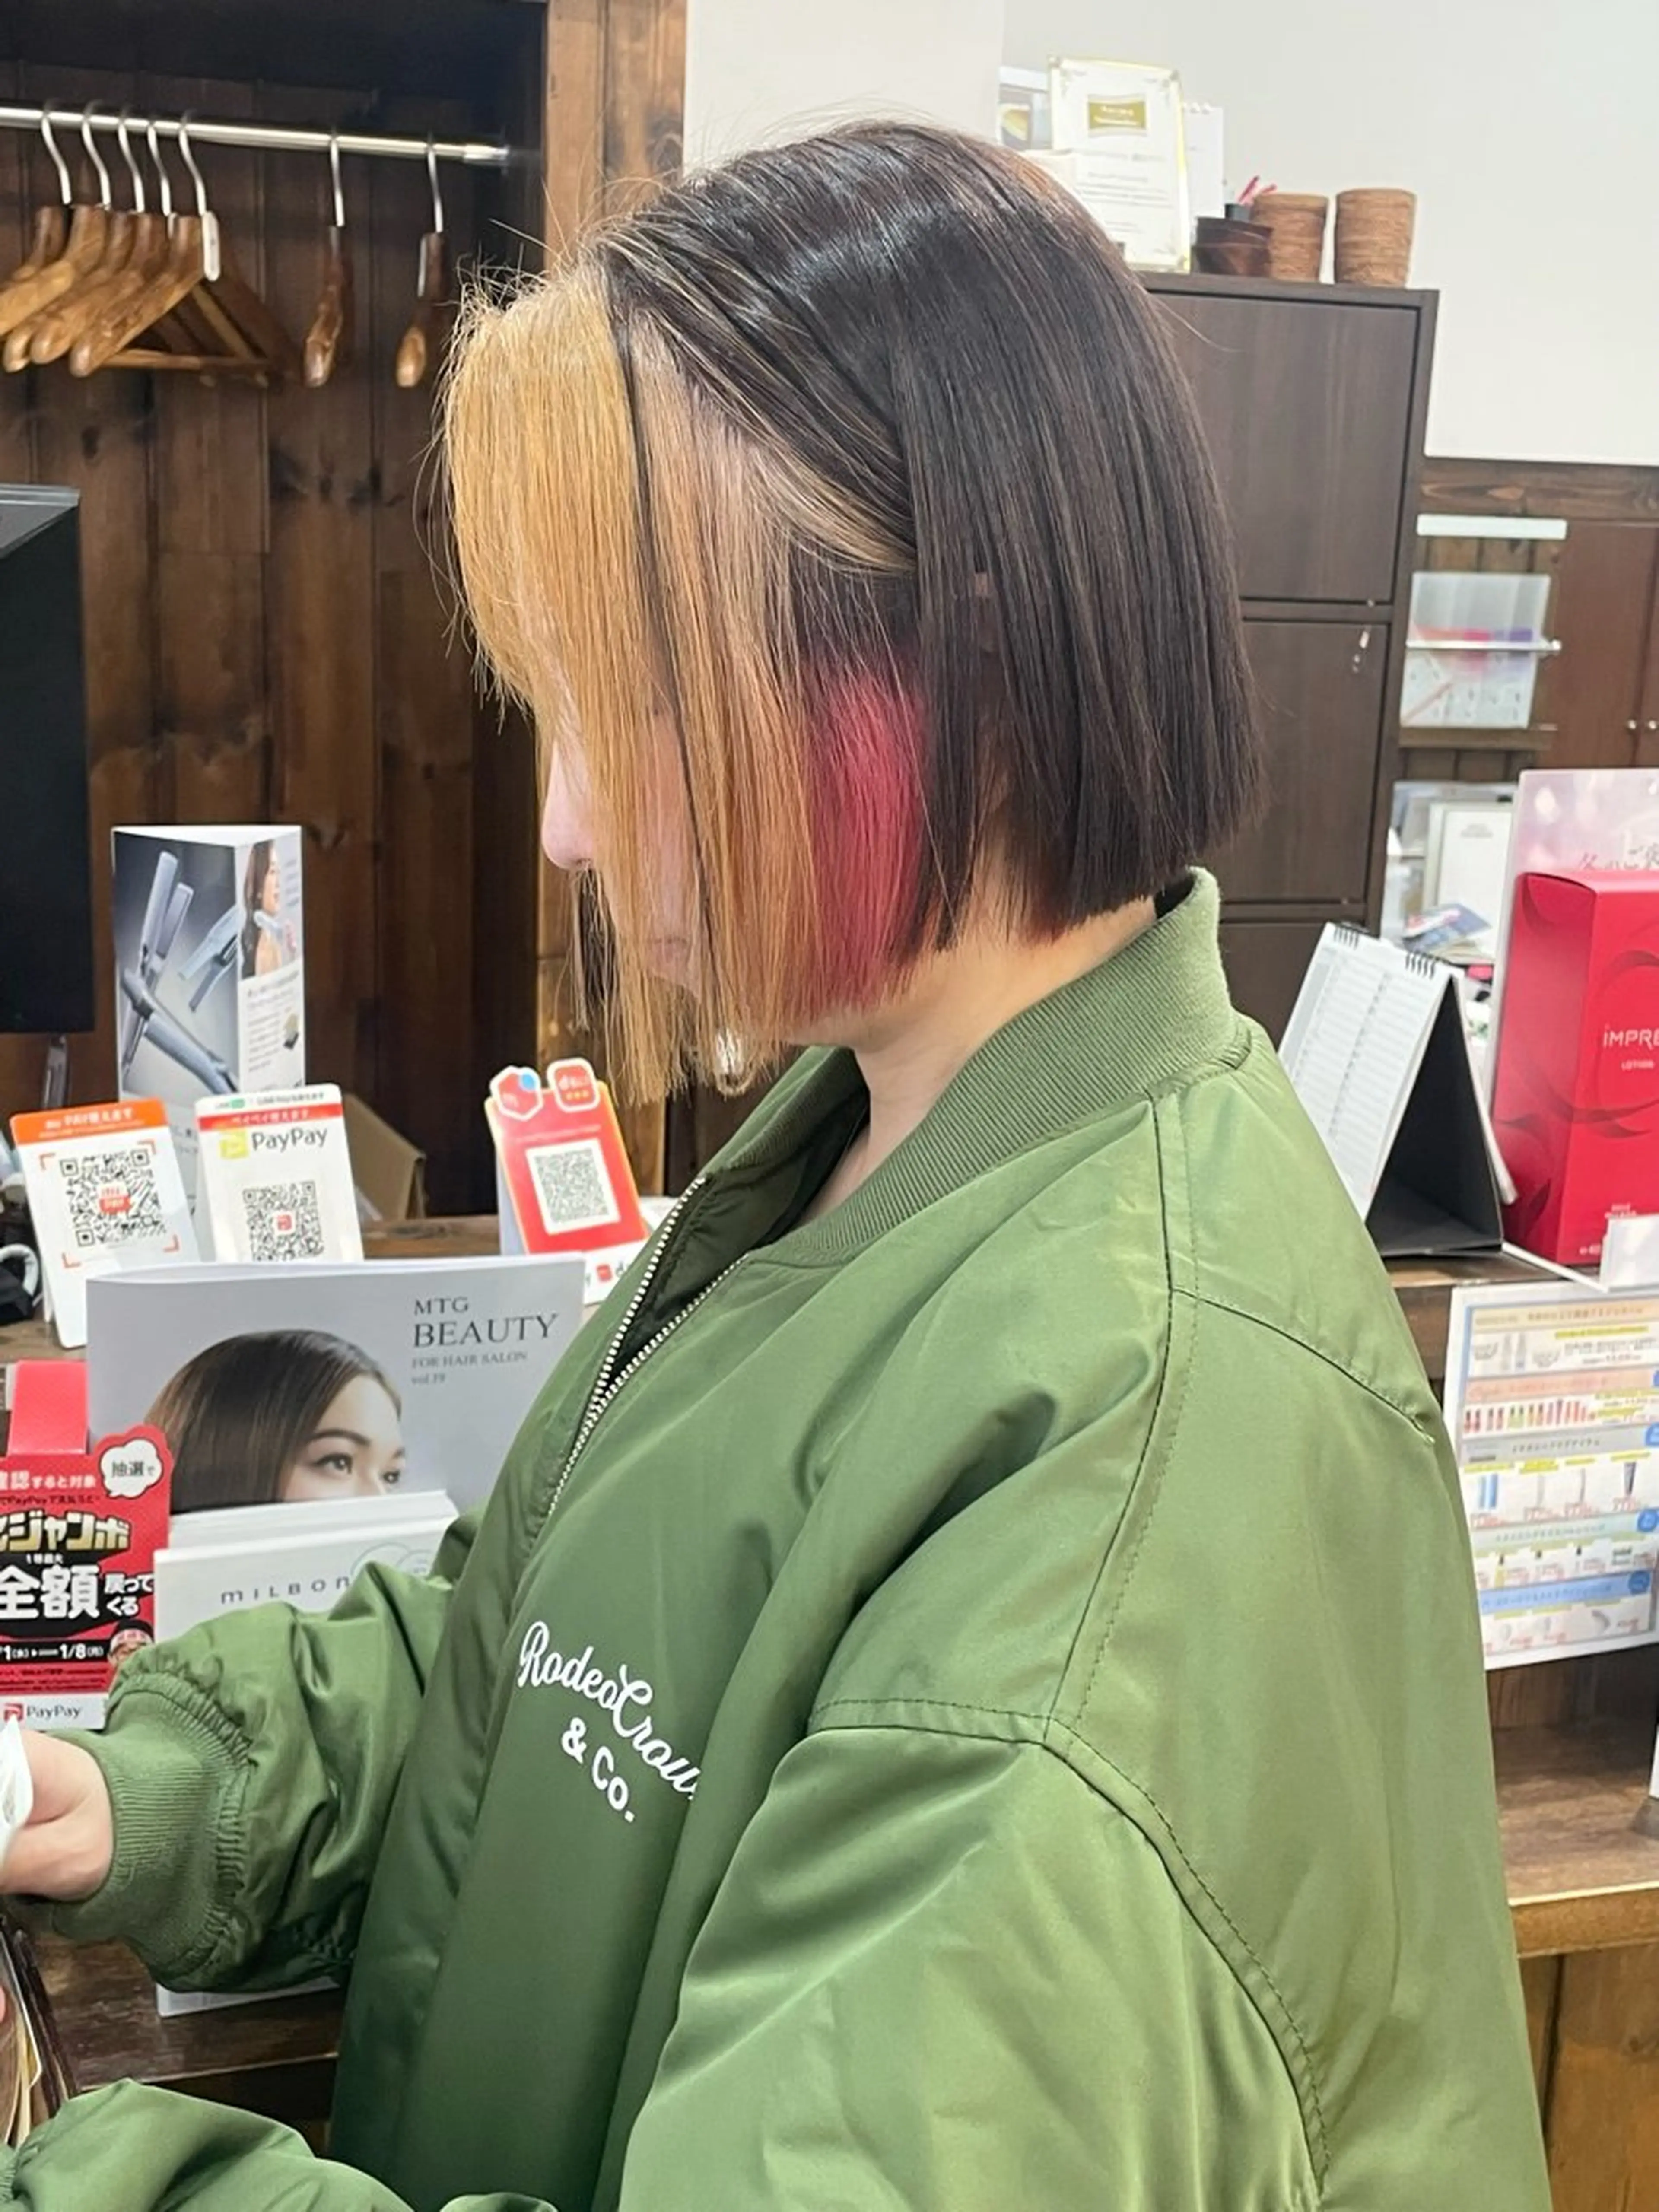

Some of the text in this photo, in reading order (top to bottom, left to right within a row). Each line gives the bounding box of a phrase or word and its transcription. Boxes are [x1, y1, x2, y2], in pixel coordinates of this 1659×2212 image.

[251, 1127, 327, 1153] PayPay
[414, 1297, 468, 1316] MTG
[414, 1313, 559, 1348] BEAUTY
[412, 1351, 528, 1368] FOR HAIR SALON
[0, 1564, 100, 1619] 全額
[107, 1596, 139, 1617] くる
[518, 1621, 617, 1710] Rodeo
[27, 1705, 81, 1718] PayPay
[562, 1717, 636, 1822] & Co.
